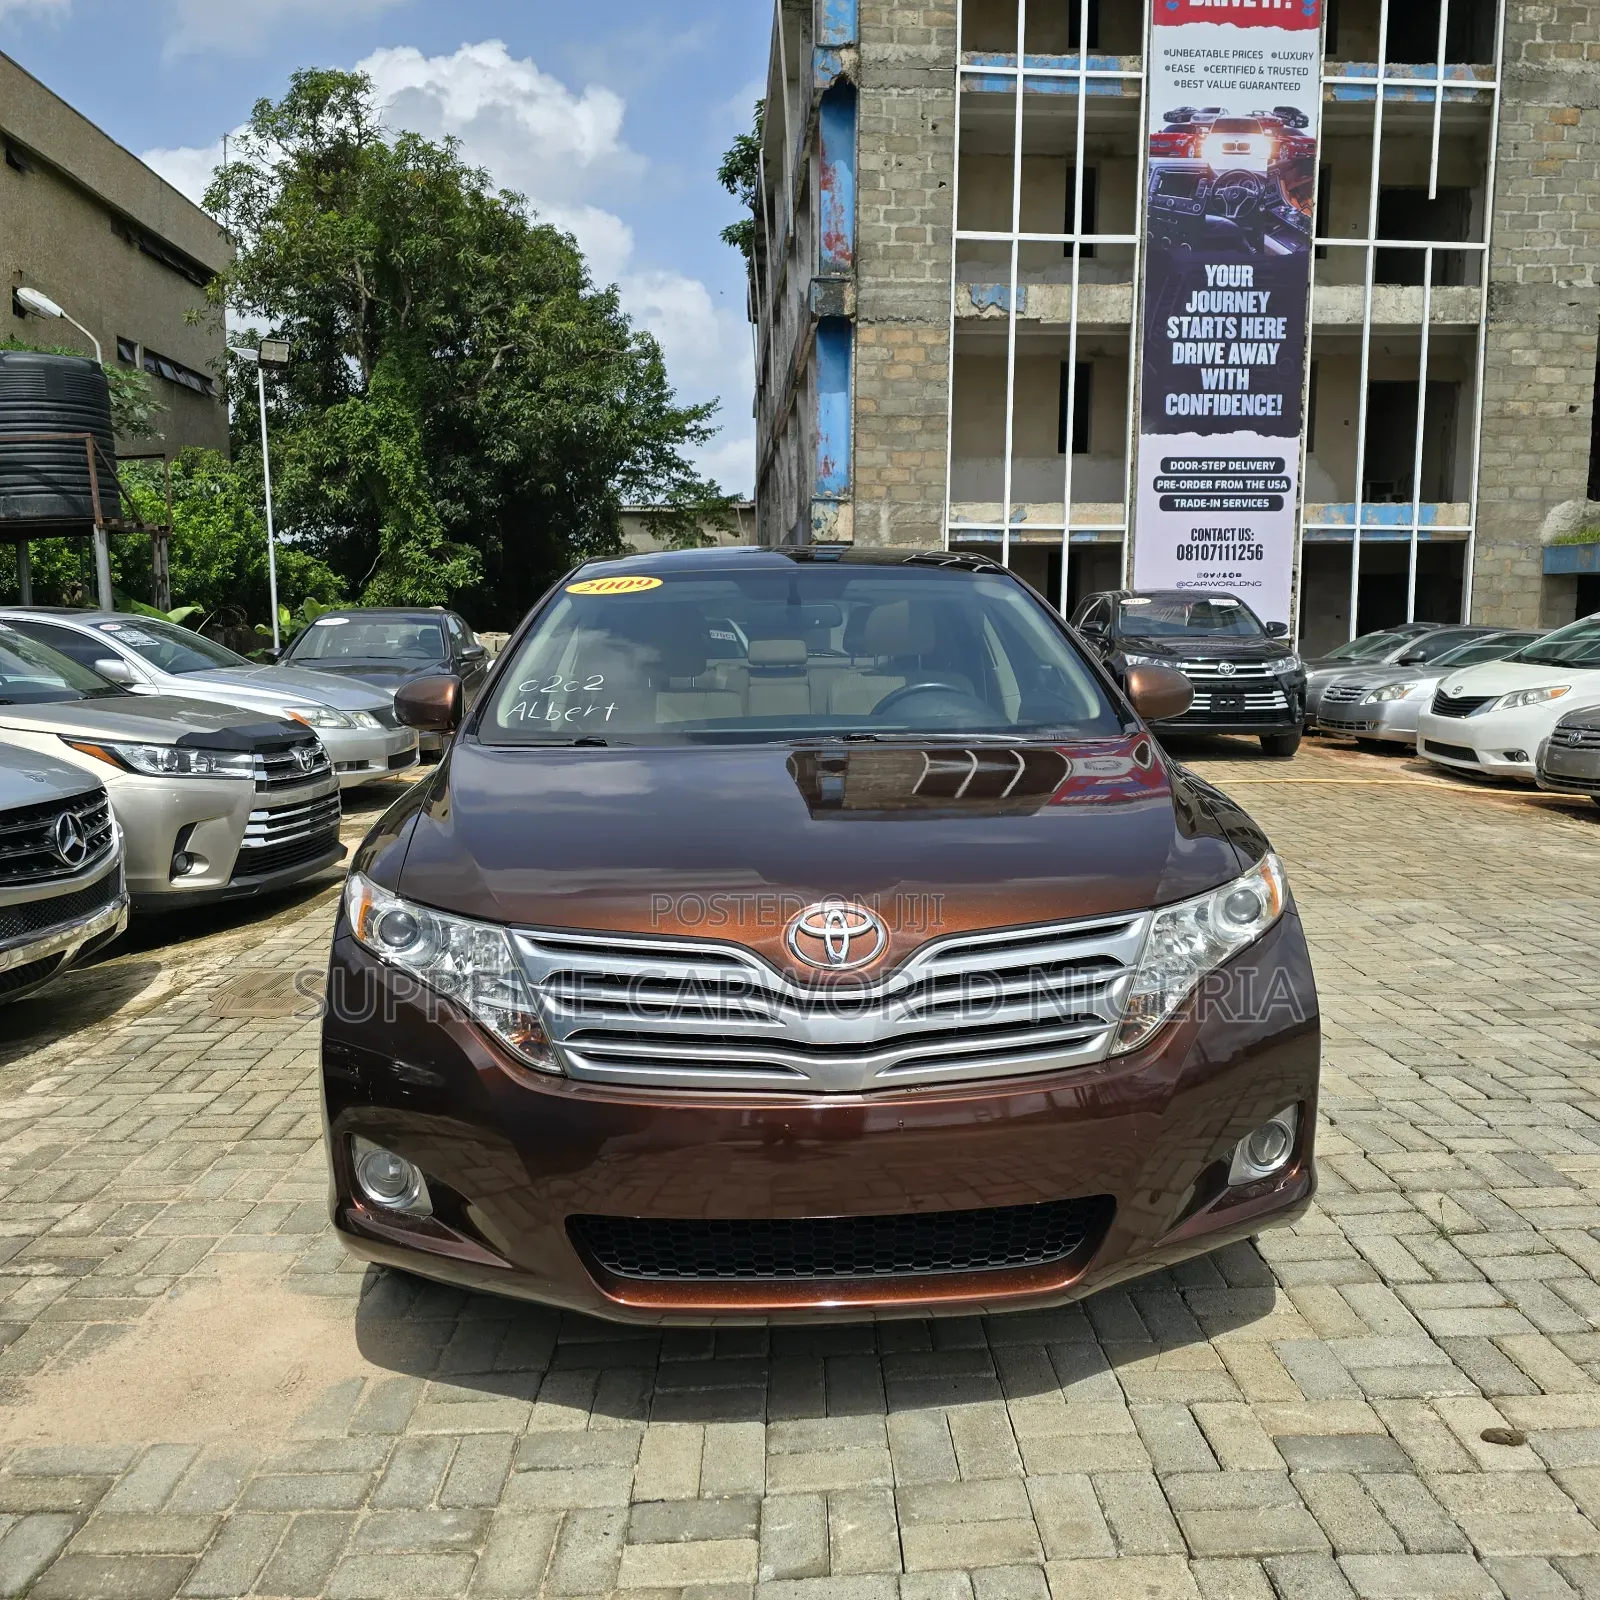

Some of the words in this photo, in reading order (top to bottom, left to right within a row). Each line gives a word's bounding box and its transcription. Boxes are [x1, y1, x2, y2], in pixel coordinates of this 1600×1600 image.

[1169, 48, 1230, 59] UNBEATABLE
[1232, 50, 1264, 60] PRICES
[1278, 51, 1314, 61] LUXURY
[1171, 64, 1196, 73] EASE
[1209, 65, 1256, 75] CERTIFIED
[1258, 66, 1265, 75] &
[1267, 66, 1309, 76] TRUSTED
[1181, 79, 1204, 89] BEST
[1206, 80, 1237, 90] VALUE
[1239, 81, 1301, 91] GUARANTEED
[1204, 264, 1254, 287] YOUR
[1185, 290, 1271, 313] JOURNEY
[1166, 316, 1238, 339] STARTS
[1240, 317, 1288, 339] HERE
[1172, 342, 1226, 365] DRIVE
[1227, 342, 1280, 365] AWAY
[1201, 368, 1250, 390] WITH
[1165, 393, 1283, 416] CONFIDENCE!
[1170, 461, 1226, 470] DOOR-STEP
[1228, 461, 1276, 471] DELIVERY
[1156, 479, 1213, 489] PRE-ORDER
[1214, 479, 1244, 489] FROM
[1245, 479, 1265, 489] THE
[1267, 480, 1288, 489] USA
[1174, 498, 1221, 508] TRADE-IN
[1222, 498, 1270, 508] SERVICES
[1190, 528, 1237, 542] CONTACT
[1238, 528, 1255, 542] US:
[1176, 544, 1264, 561] 08107111256
[575, 579, 654, 593] 2009
[1176, 580, 1263, 589] @CARWORLDNG
